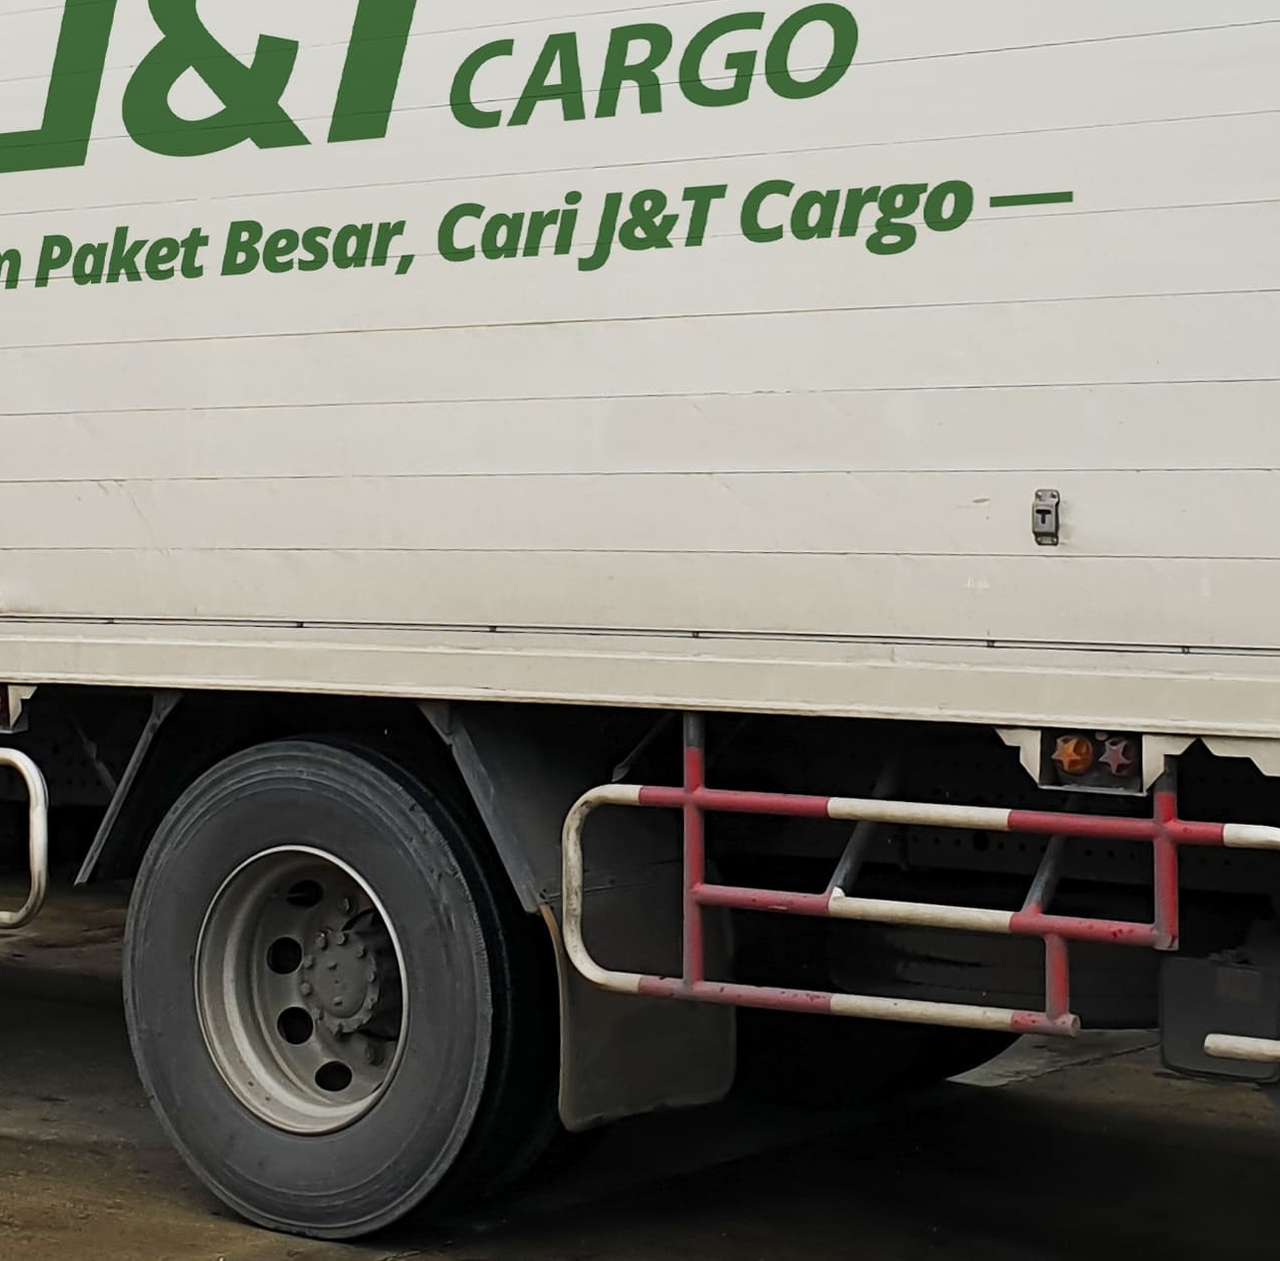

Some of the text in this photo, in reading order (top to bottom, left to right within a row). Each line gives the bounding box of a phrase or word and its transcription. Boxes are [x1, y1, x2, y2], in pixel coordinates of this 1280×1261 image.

[450, 2, 859, 129] CARGO
[35, 227, 210, 288] Paket
[221, 220, 415, 277] Besar,
[437, 191, 582, 264] Cari
[577, 184, 728, 272] J&T
[739, 179, 974, 257] Cargo
